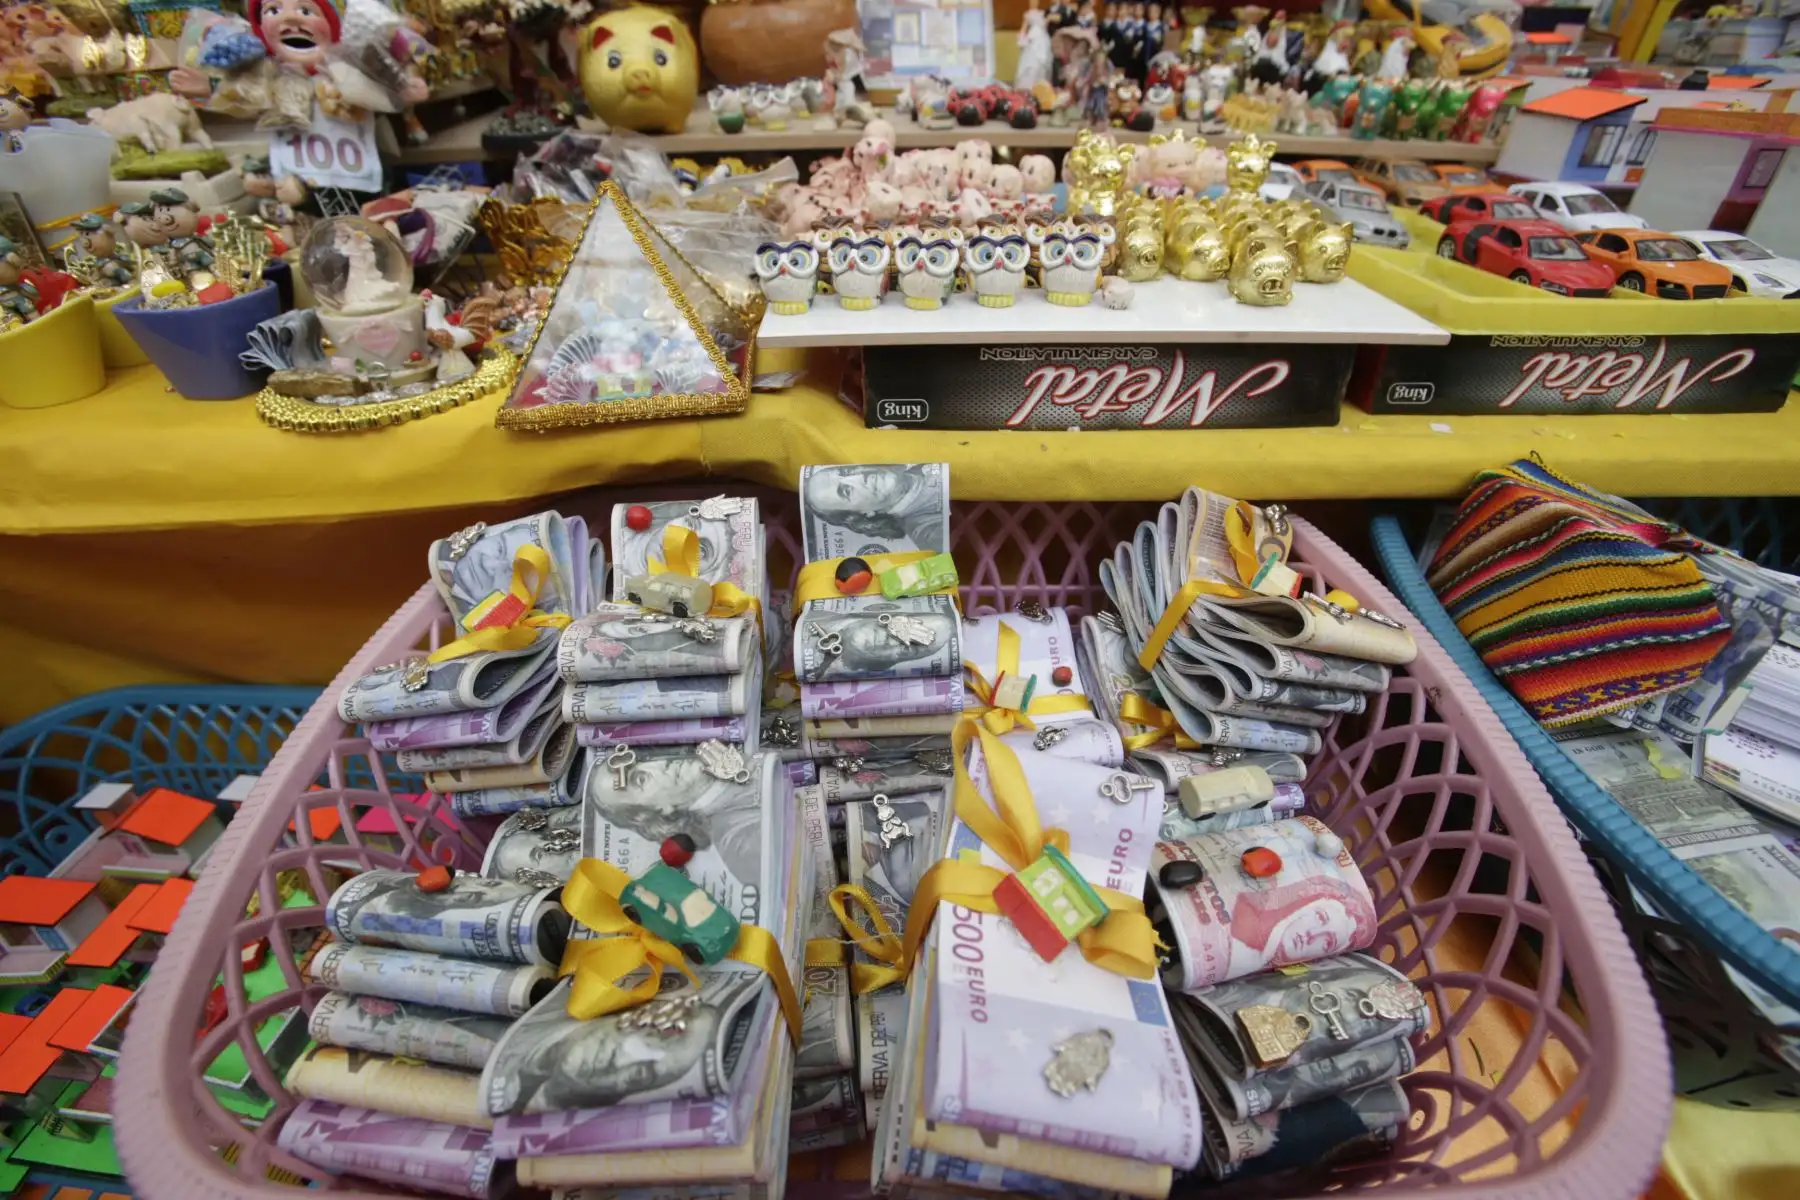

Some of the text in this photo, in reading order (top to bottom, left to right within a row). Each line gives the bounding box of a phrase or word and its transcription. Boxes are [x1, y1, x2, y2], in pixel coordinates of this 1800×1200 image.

[286, 133, 363, 173] 100
[979, 347, 1112, 362] SIMULATION
[1497, 337, 1756, 410] Metal
[1004, 348, 1291, 427] Metal
[1393, 383, 1429, 401] king
[883, 400, 922, 420] king
[803, 648, 815, 670] SIN
[1105, 827, 1134, 890] EURO
[951, 904, 990, 1024] 500 EURO
[490, 1076, 506, 1114] SIN
[469, 1156, 491, 1194] SIN
